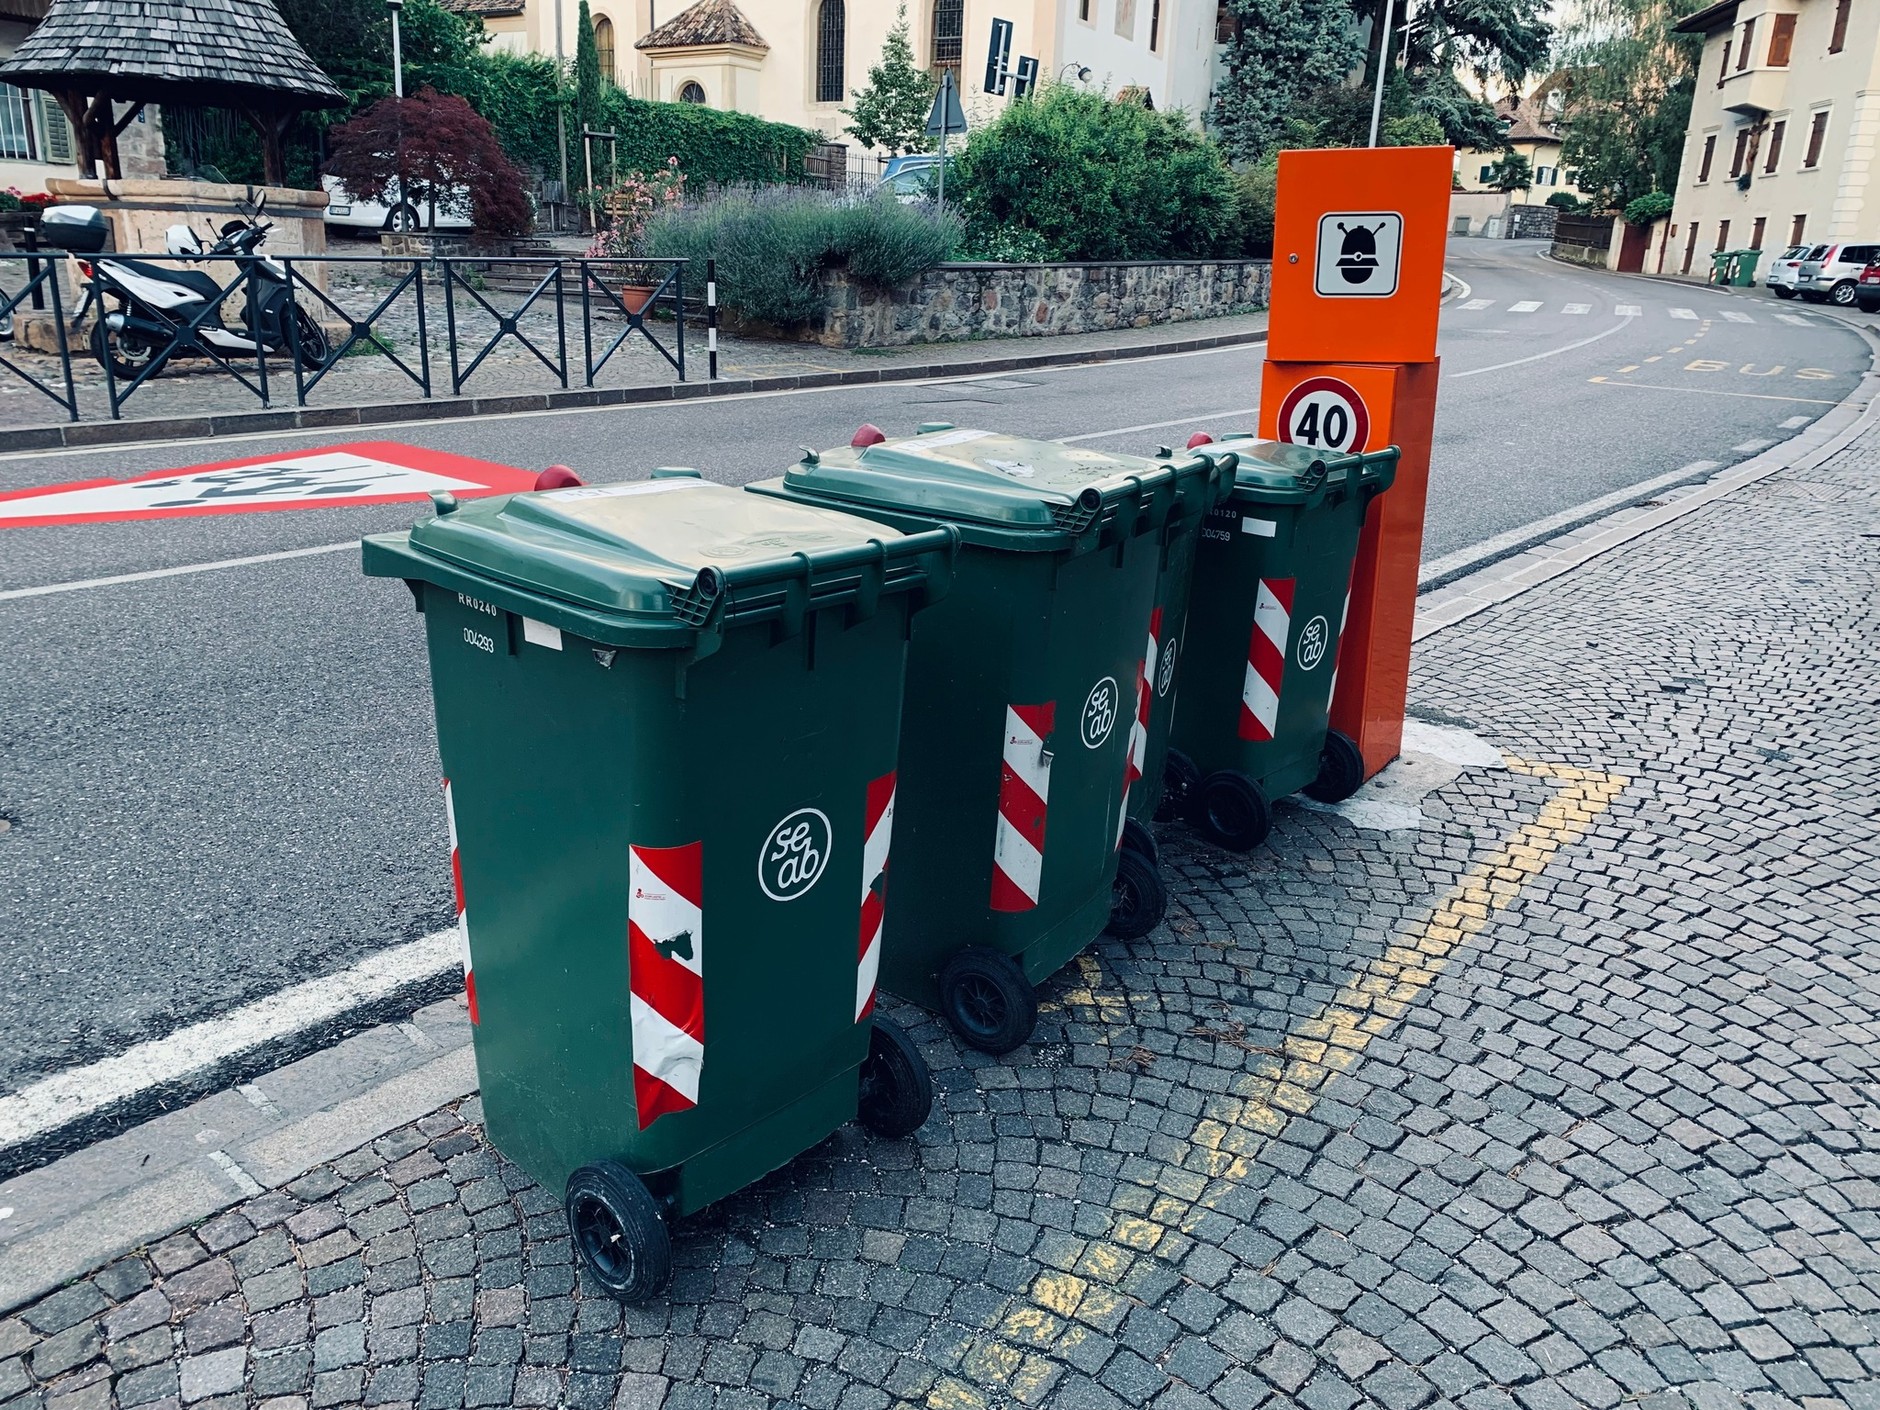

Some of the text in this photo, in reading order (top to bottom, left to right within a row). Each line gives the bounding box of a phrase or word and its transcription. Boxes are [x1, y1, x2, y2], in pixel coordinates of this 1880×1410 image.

[1684, 359, 1836, 380] BUS
[1295, 402, 1348, 449] 40
[458, 592, 497, 617] RR0240
[463, 627, 494, 654] 004293
